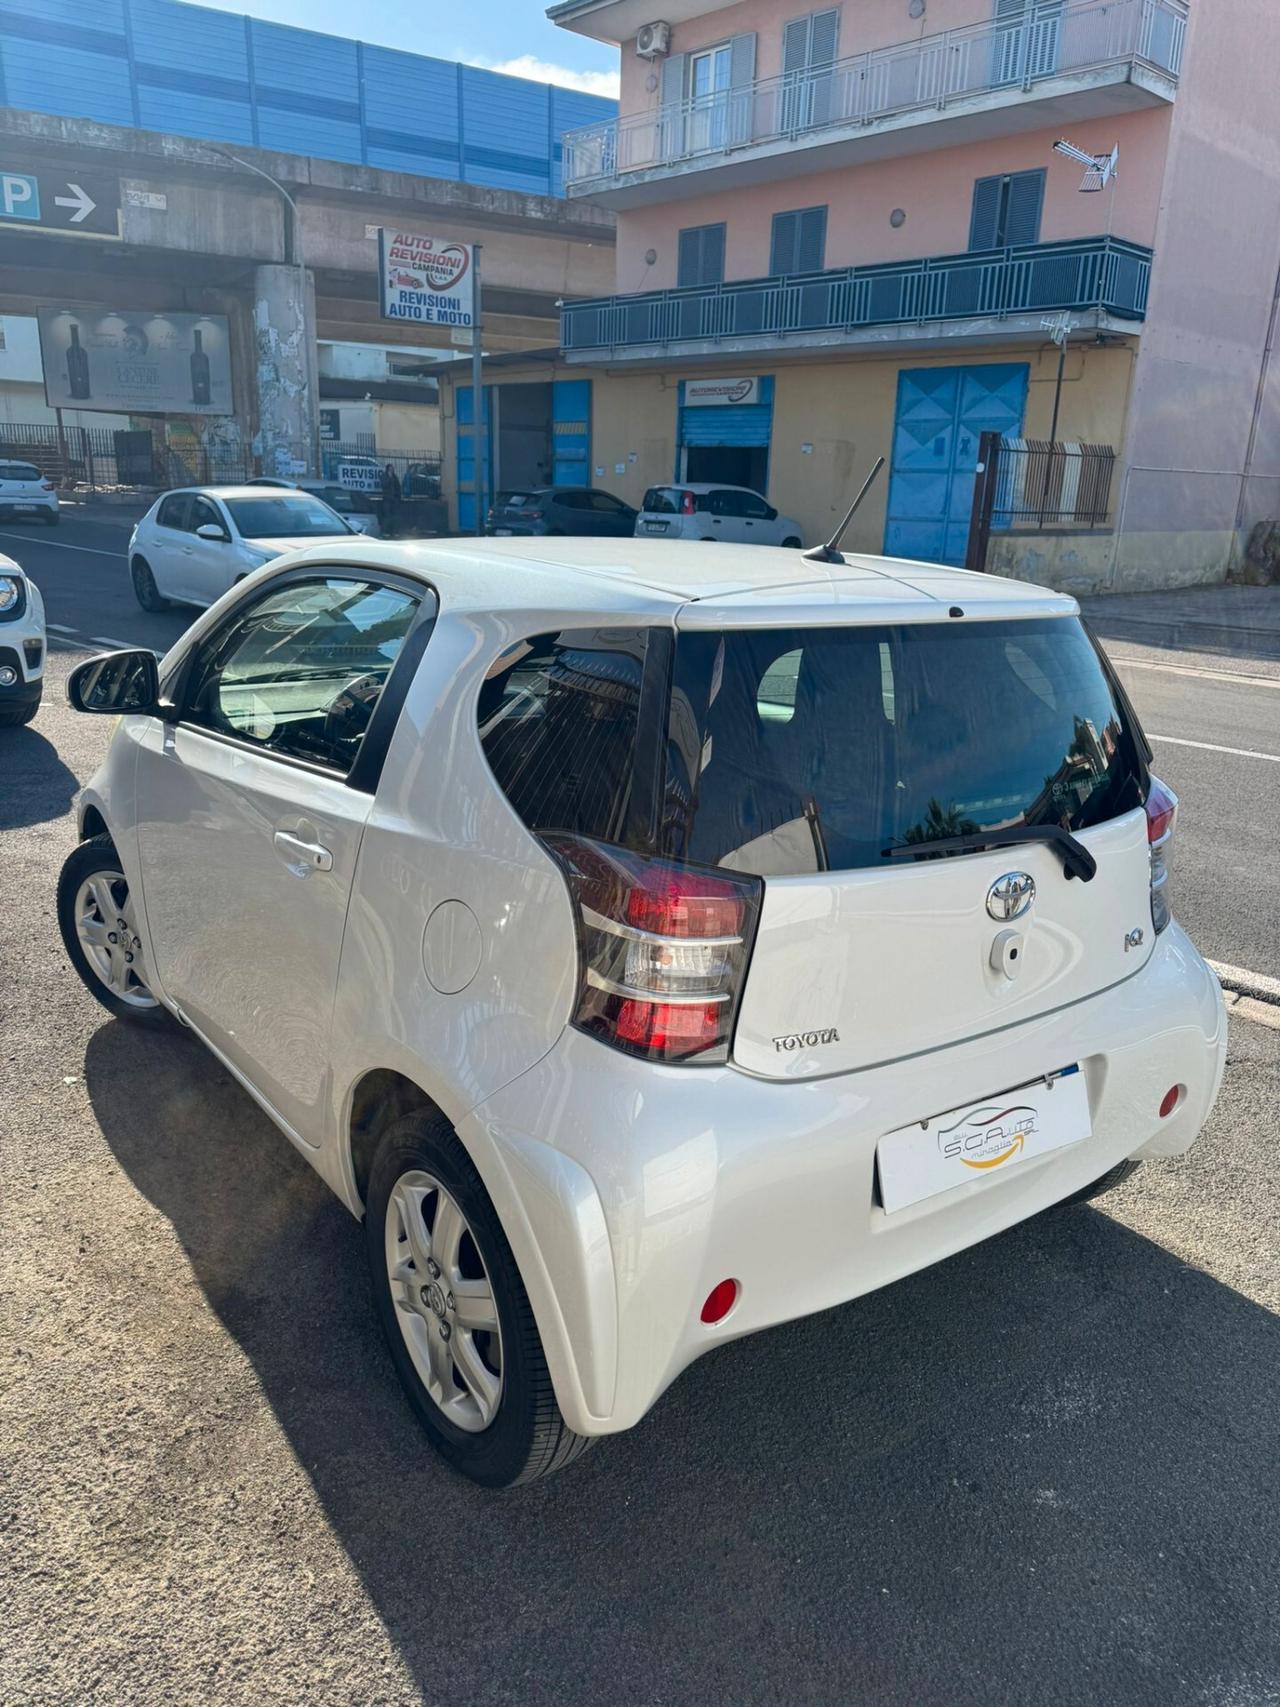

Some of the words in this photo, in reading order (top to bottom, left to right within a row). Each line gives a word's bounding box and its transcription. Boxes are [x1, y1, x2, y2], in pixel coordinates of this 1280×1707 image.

[2, 176, 32, 213] P
[393, 233, 433, 250] AUTO
[389, 247, 462, 269] REVISIONI
[411, 262, 454, 277] CAMPANIA
[400, 290, 461, 311] REVISIONI
[389, 303, 422, 319] AUTO
[426, 308, 434, 321] E
[437, 309, 471, 326] MOTO
[772, 1028, 840, 1053] TOYOTA
